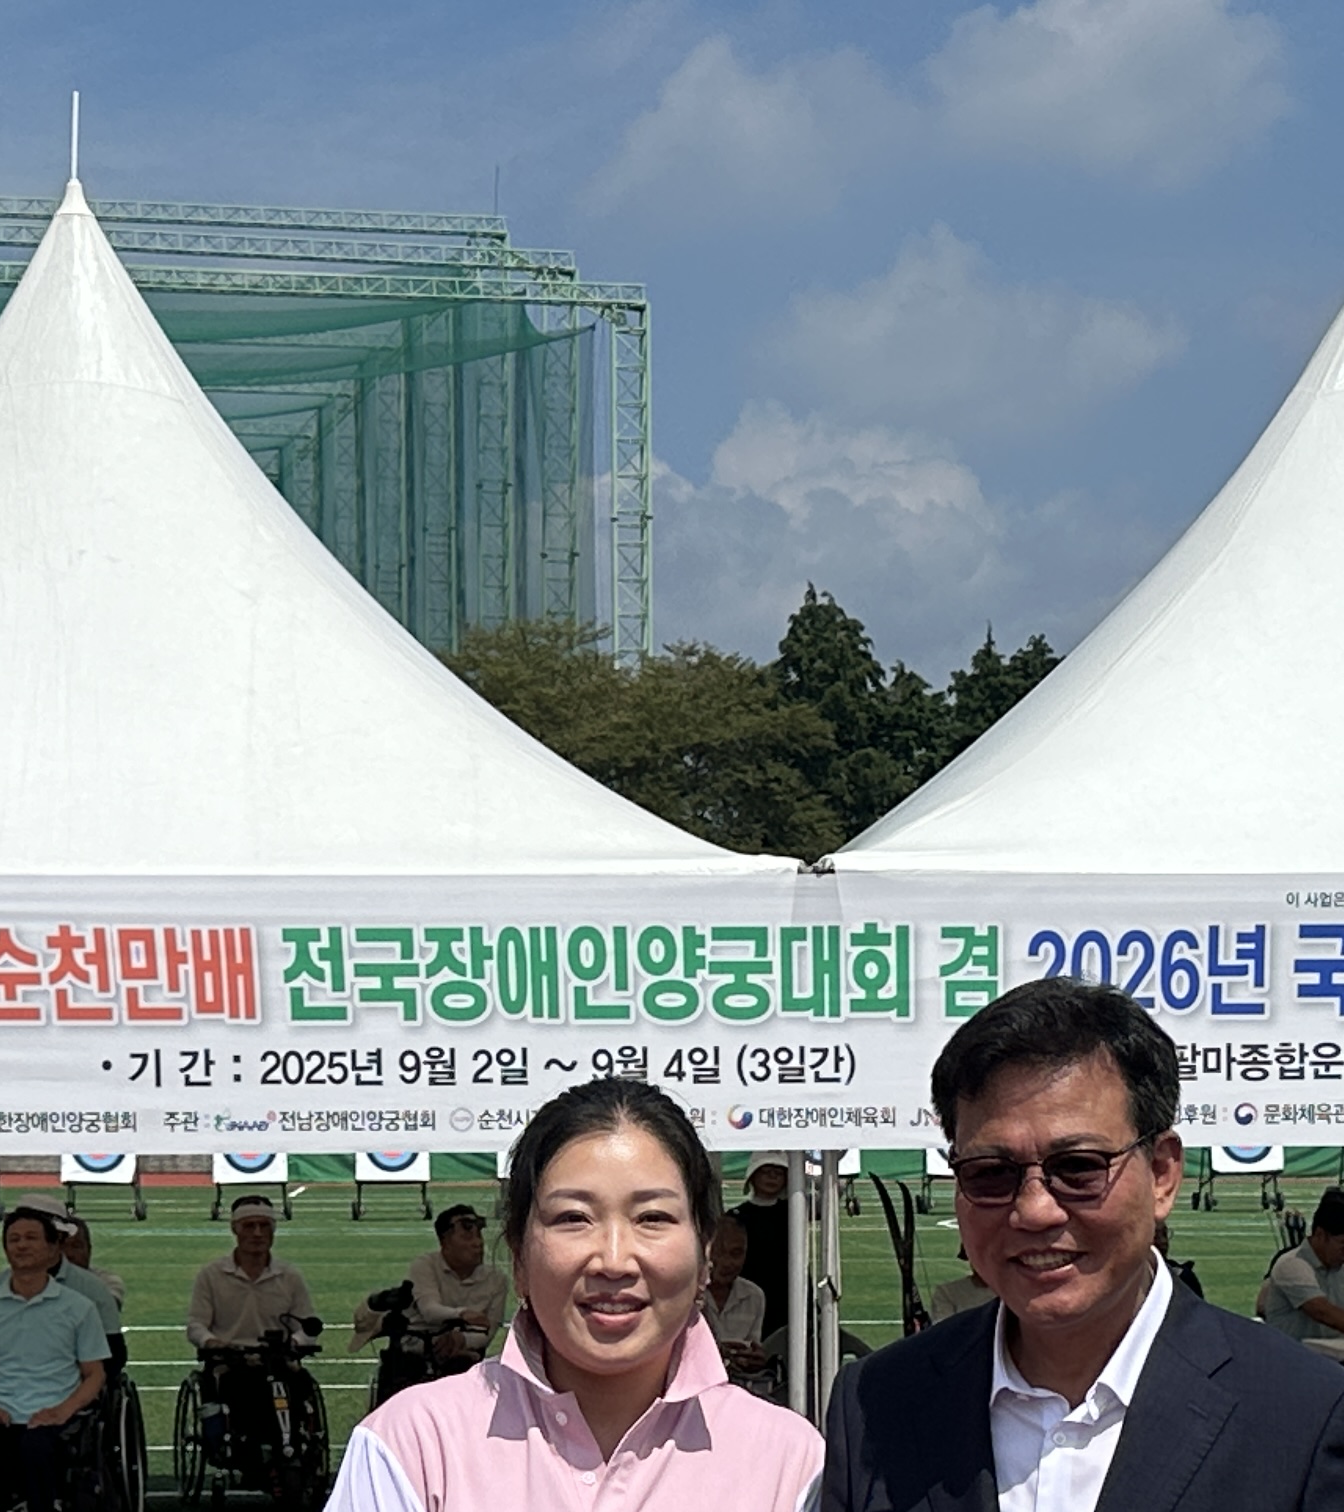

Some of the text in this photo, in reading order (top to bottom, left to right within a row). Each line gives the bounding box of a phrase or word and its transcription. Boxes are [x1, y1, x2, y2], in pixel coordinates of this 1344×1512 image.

[1286, 891, 1301, 909] 이
[281, 923, 911, 1022] 전국장애인양궁대회
[939, 925, 998, 1017] 겸
[1028, 923, 1267, 1017] 2026년
[260, 1048, 385, 1087] 2025년
[399, 1047, 458, 1087] 9월
[472, 1047, 530, 1087] 2일
[591, 1046, 649, 1082] 9월
[662, 1045, 722, 1086] 4일
[736, 1043, 857, 1088] (3일간)
[163, 1111, 201, 1133] 주관
[278, 1110, 437, 1133] 전남장애인양궁협회
[477, 1109, 533, 1131] 순천시
[759, 1107, 897, 1130] 대한장애인체육회
